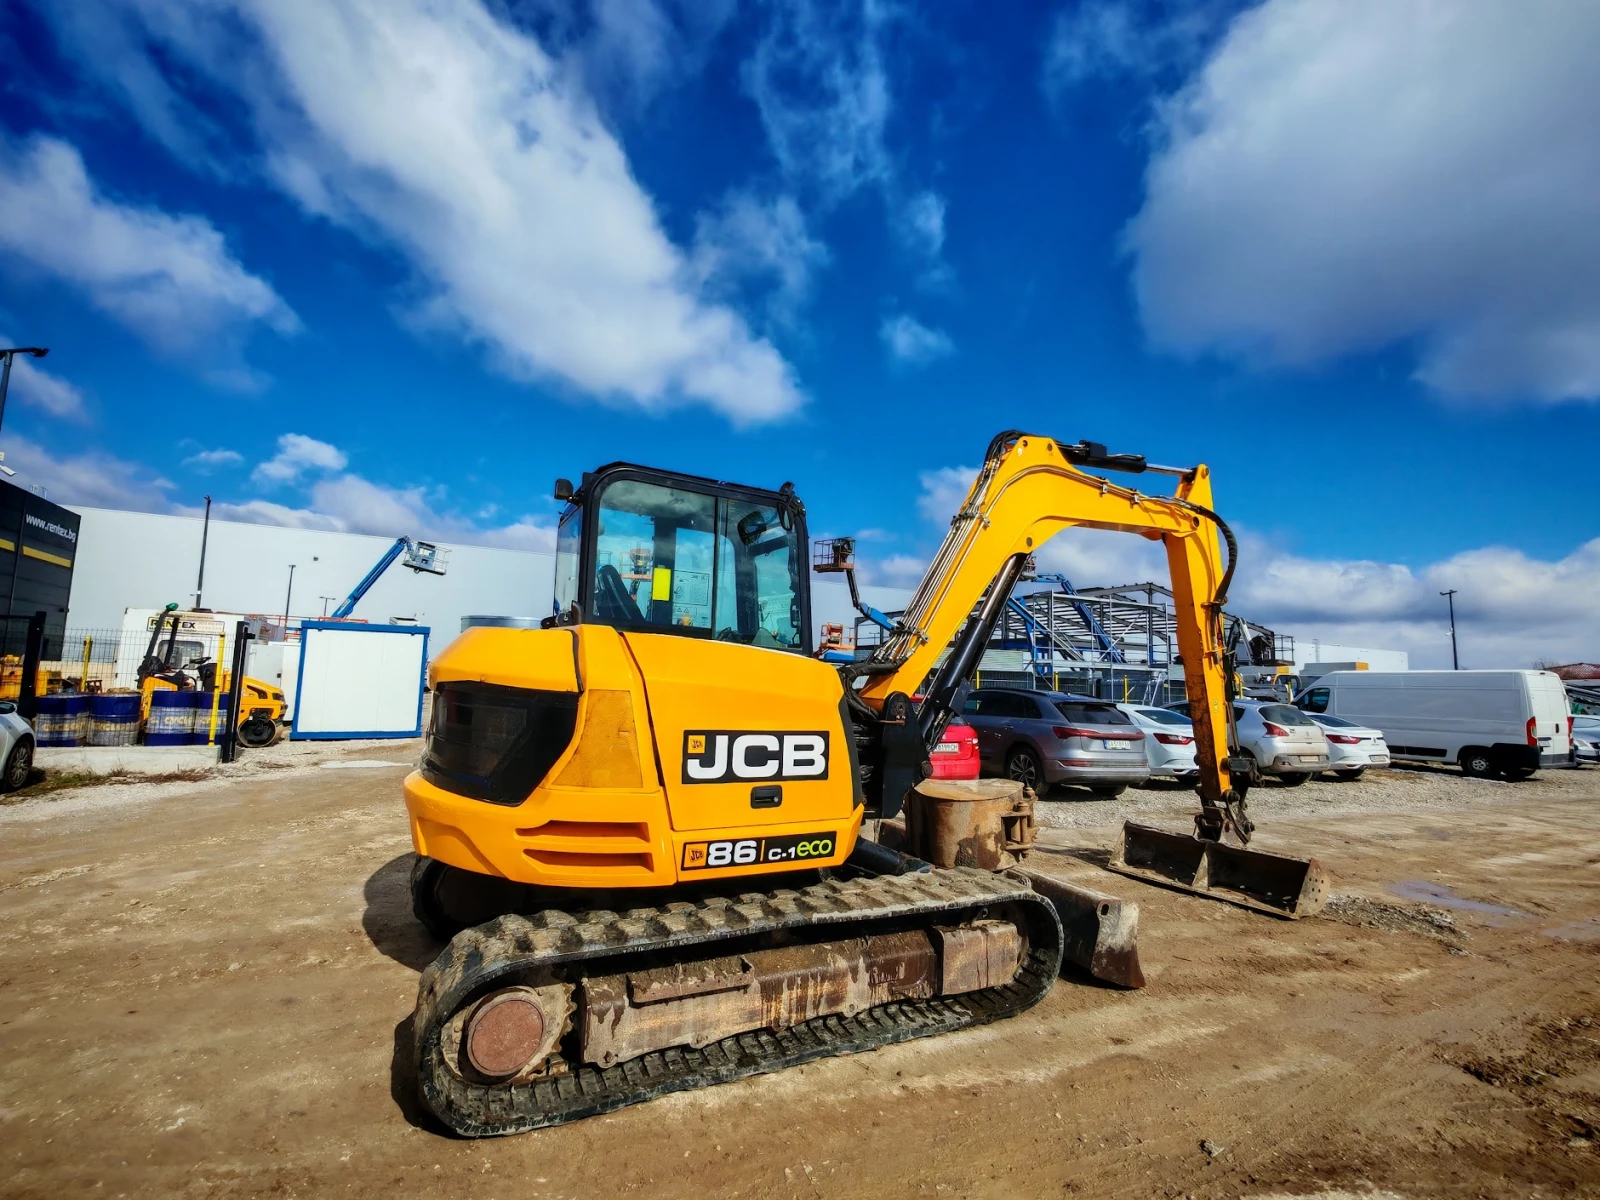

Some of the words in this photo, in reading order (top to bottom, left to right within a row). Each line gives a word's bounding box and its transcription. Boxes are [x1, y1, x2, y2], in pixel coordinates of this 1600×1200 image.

[26, 514, 76, 542] www.rentex.bg
[687, 734, 826, 779] JCB
[690, 849, 704, 861] JCB
[707, 840, 757, 866] 86
[768, 846, 796, 861] C-1
[796, 839, 833, 857] eco
